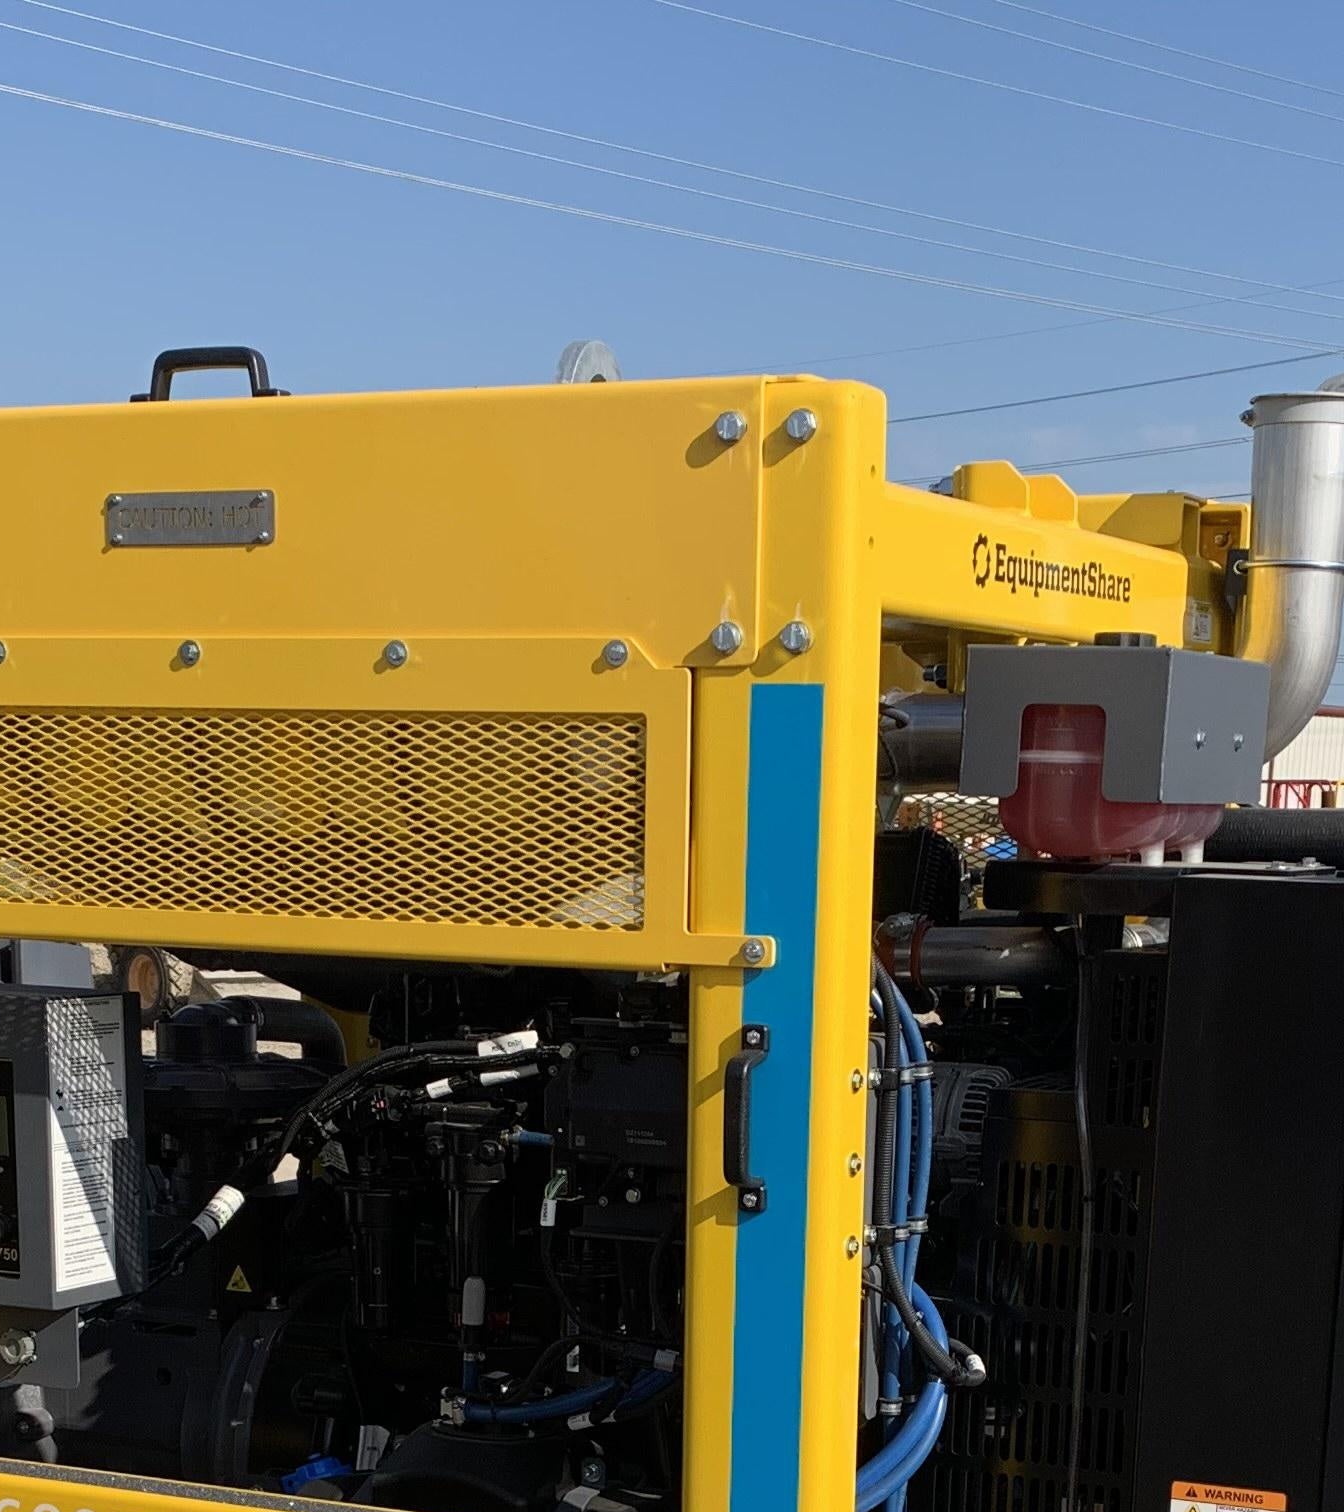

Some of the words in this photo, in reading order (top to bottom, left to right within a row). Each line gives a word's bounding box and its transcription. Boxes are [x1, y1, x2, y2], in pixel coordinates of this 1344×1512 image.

[118, 505, 213, 531] CAUTION:
[221, 503, 266, 530] HOT
[994, 542, 1132, 603] EquipmentShare
[1204, 1487, 1264, 1505] WARNING
